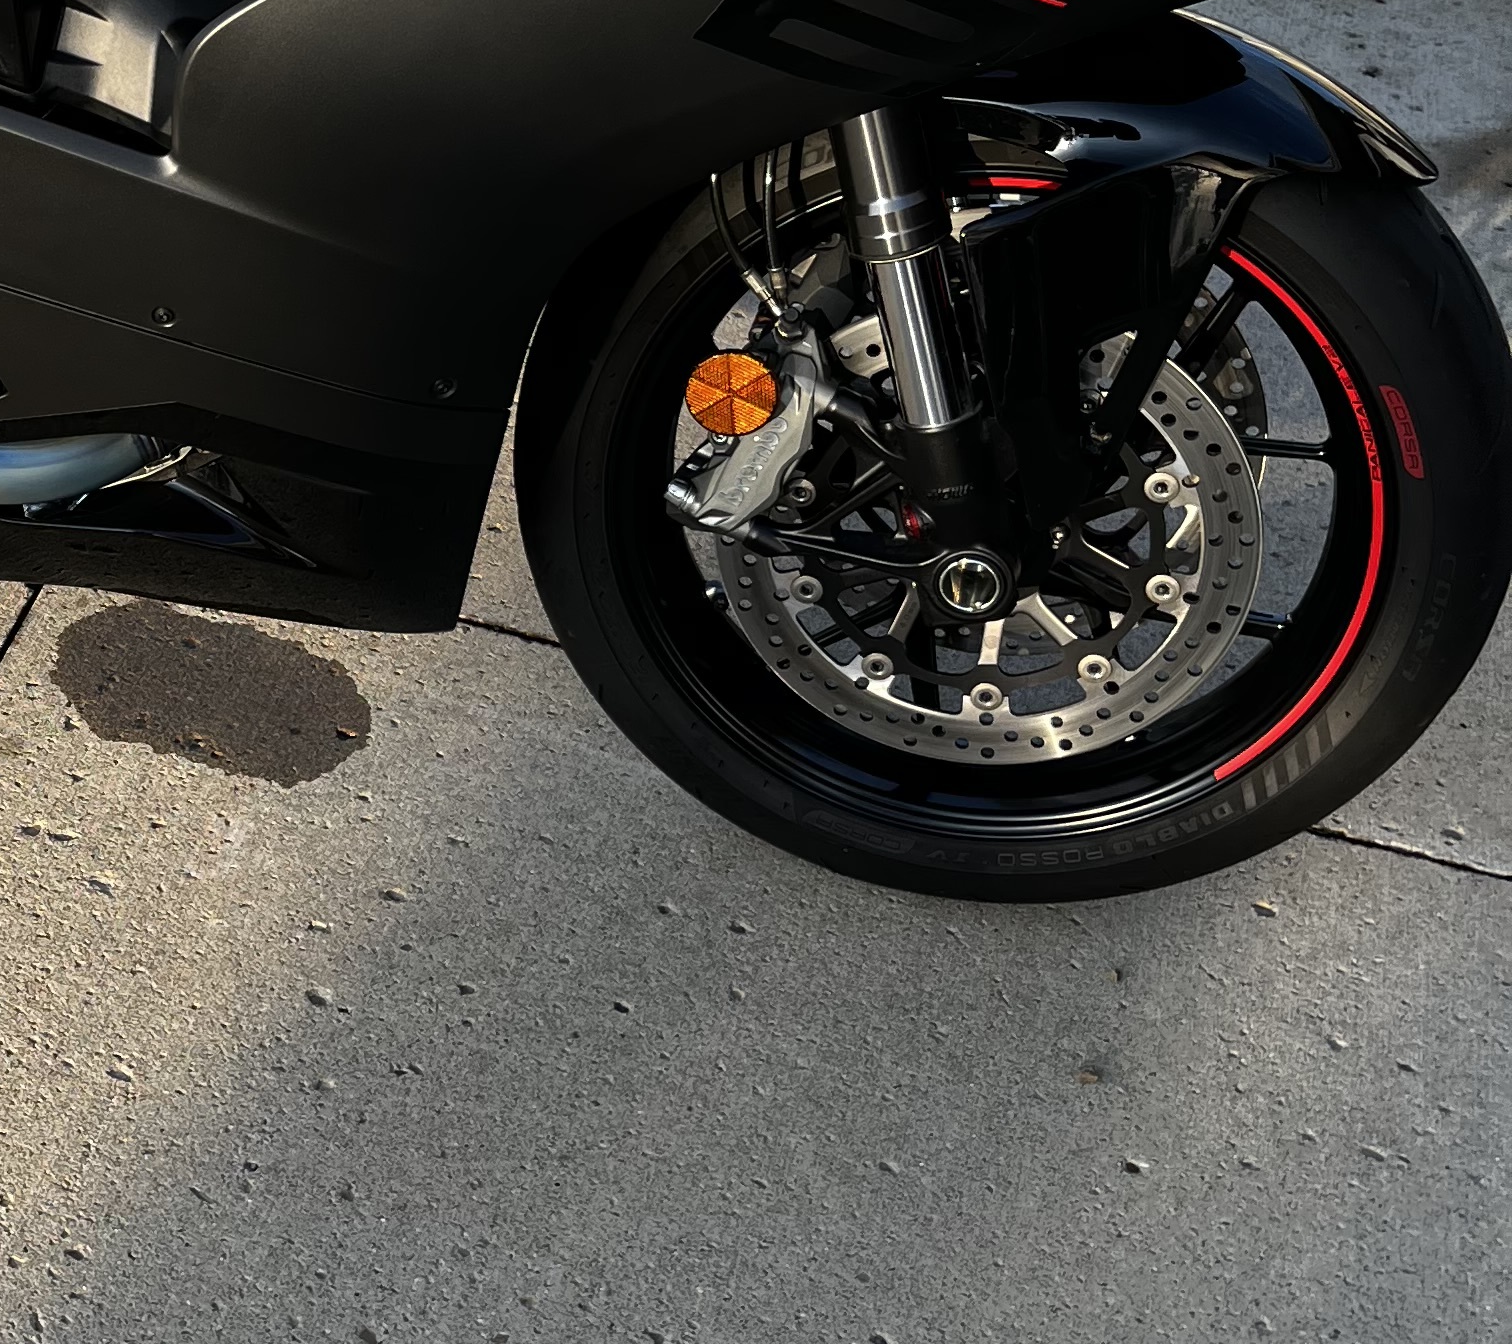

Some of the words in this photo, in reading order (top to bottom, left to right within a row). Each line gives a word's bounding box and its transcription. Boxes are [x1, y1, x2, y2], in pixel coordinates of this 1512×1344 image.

[1386, 389, 1420, 470] CORSA
[717, 416, 789, 508] brembo
[816, 813, 901, 851] CORSA
[1111, 799, 1236, 856] DIABLO
[996, 845, 1105, 868] ROSSO
